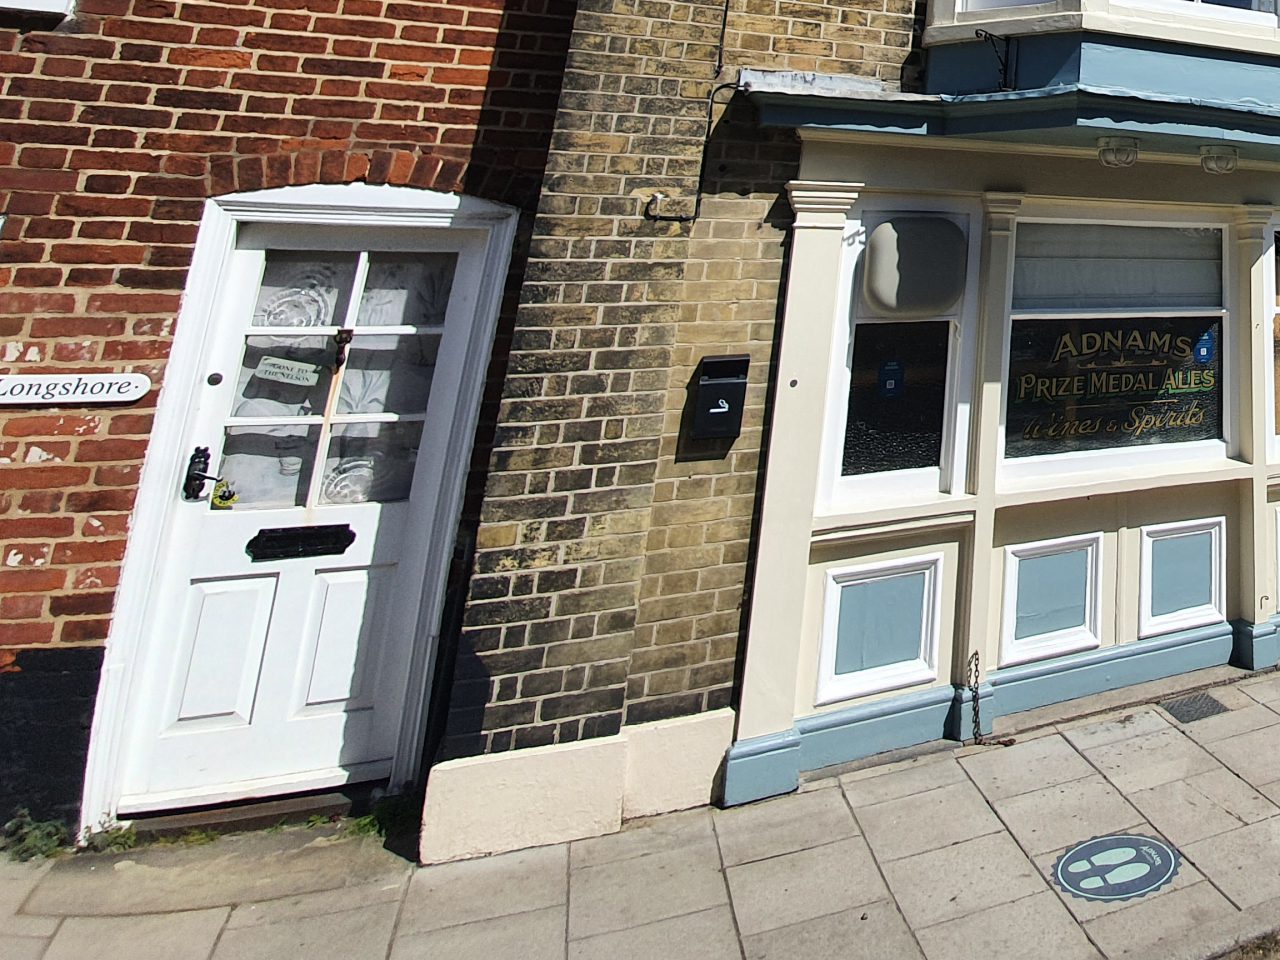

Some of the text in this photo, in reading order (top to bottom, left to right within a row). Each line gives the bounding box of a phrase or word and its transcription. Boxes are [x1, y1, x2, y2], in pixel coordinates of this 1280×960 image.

[1054, 329, 1193, 362] ADNAMS
[1018, 368, 1216, 400] PRIZE MEDAL ALES
[1120, 399, 1206, 437] Spirits
